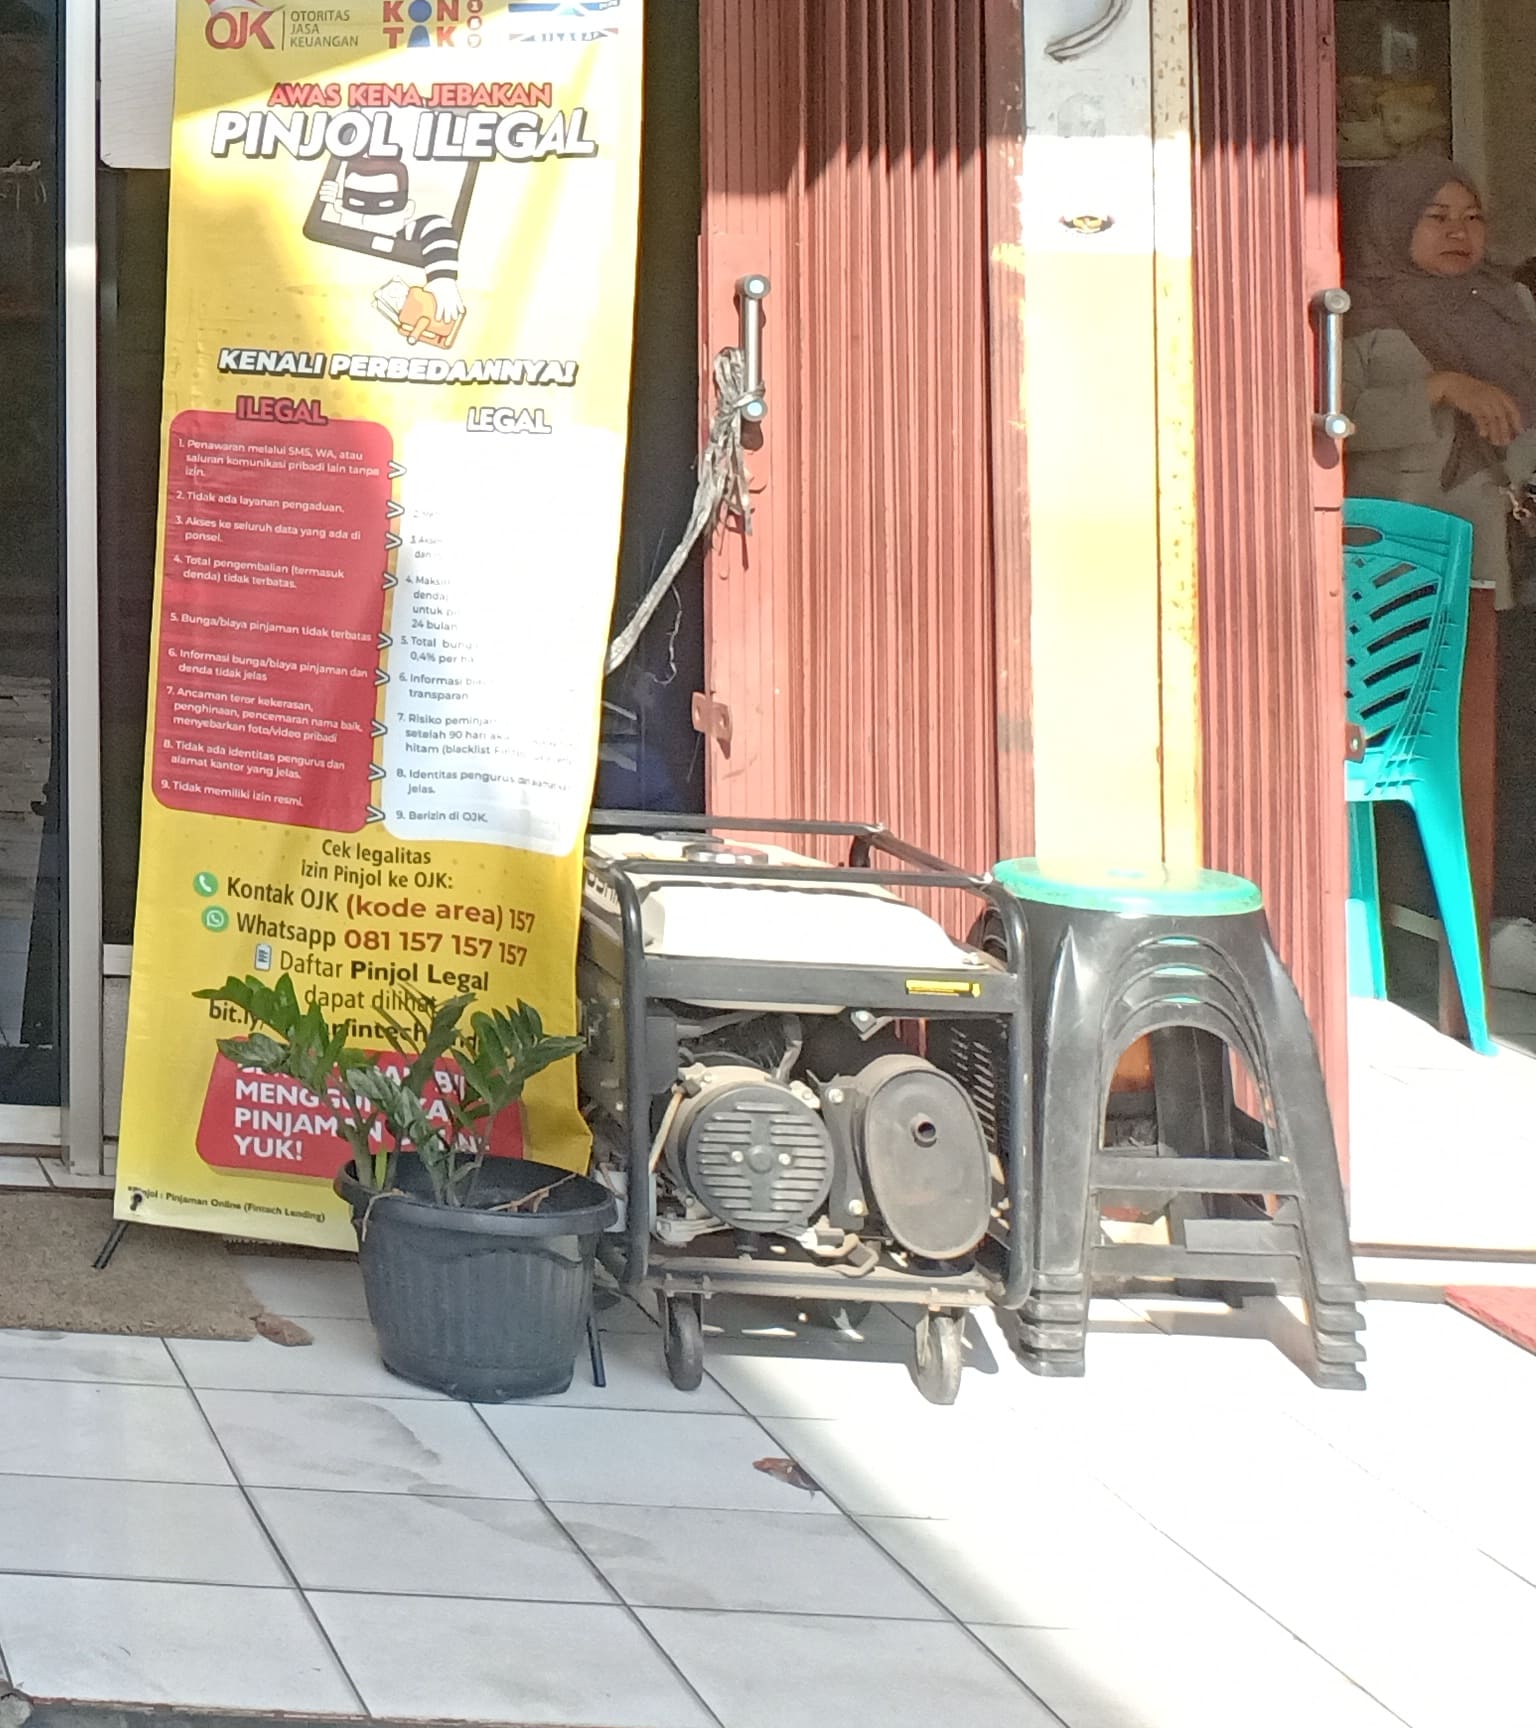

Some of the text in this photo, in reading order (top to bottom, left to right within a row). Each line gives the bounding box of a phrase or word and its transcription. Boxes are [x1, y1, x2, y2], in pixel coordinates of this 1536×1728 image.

[290, 9, 350, 23] OTORITAS
[290, 23, 320, 35] JASA
[289, 35, 359, 48] KEUANGAN
[268, 83, 552, 108] AWAS KENA JEBAKAN
[211, 108, 598, 160] PINJOL ILEGAL
[218, 348, 578, 386] KENALI PERBEDAANNYA!
[236, 396, 552, 434] ILEGAL LEGAL
[322, 839, 431, 867] Cek legalitas
[333, 865, 382, 889] Pinjol
[388, 871, 409, 889] ke
[414, 872, 453, 891] OJK:
[227, 877, 536, 933] Kontak OJK (kode area) 157
[236, 912, 528, 967] Whatsapp 081 157 157 157
[280, 951, 489, 991] Daftar Pinjol Legal
[305, 987, 365, 1012] dapat
[233, 1134, 302, 1160] YUK!
[166, 1192, 208, 1206] Pinjaman
